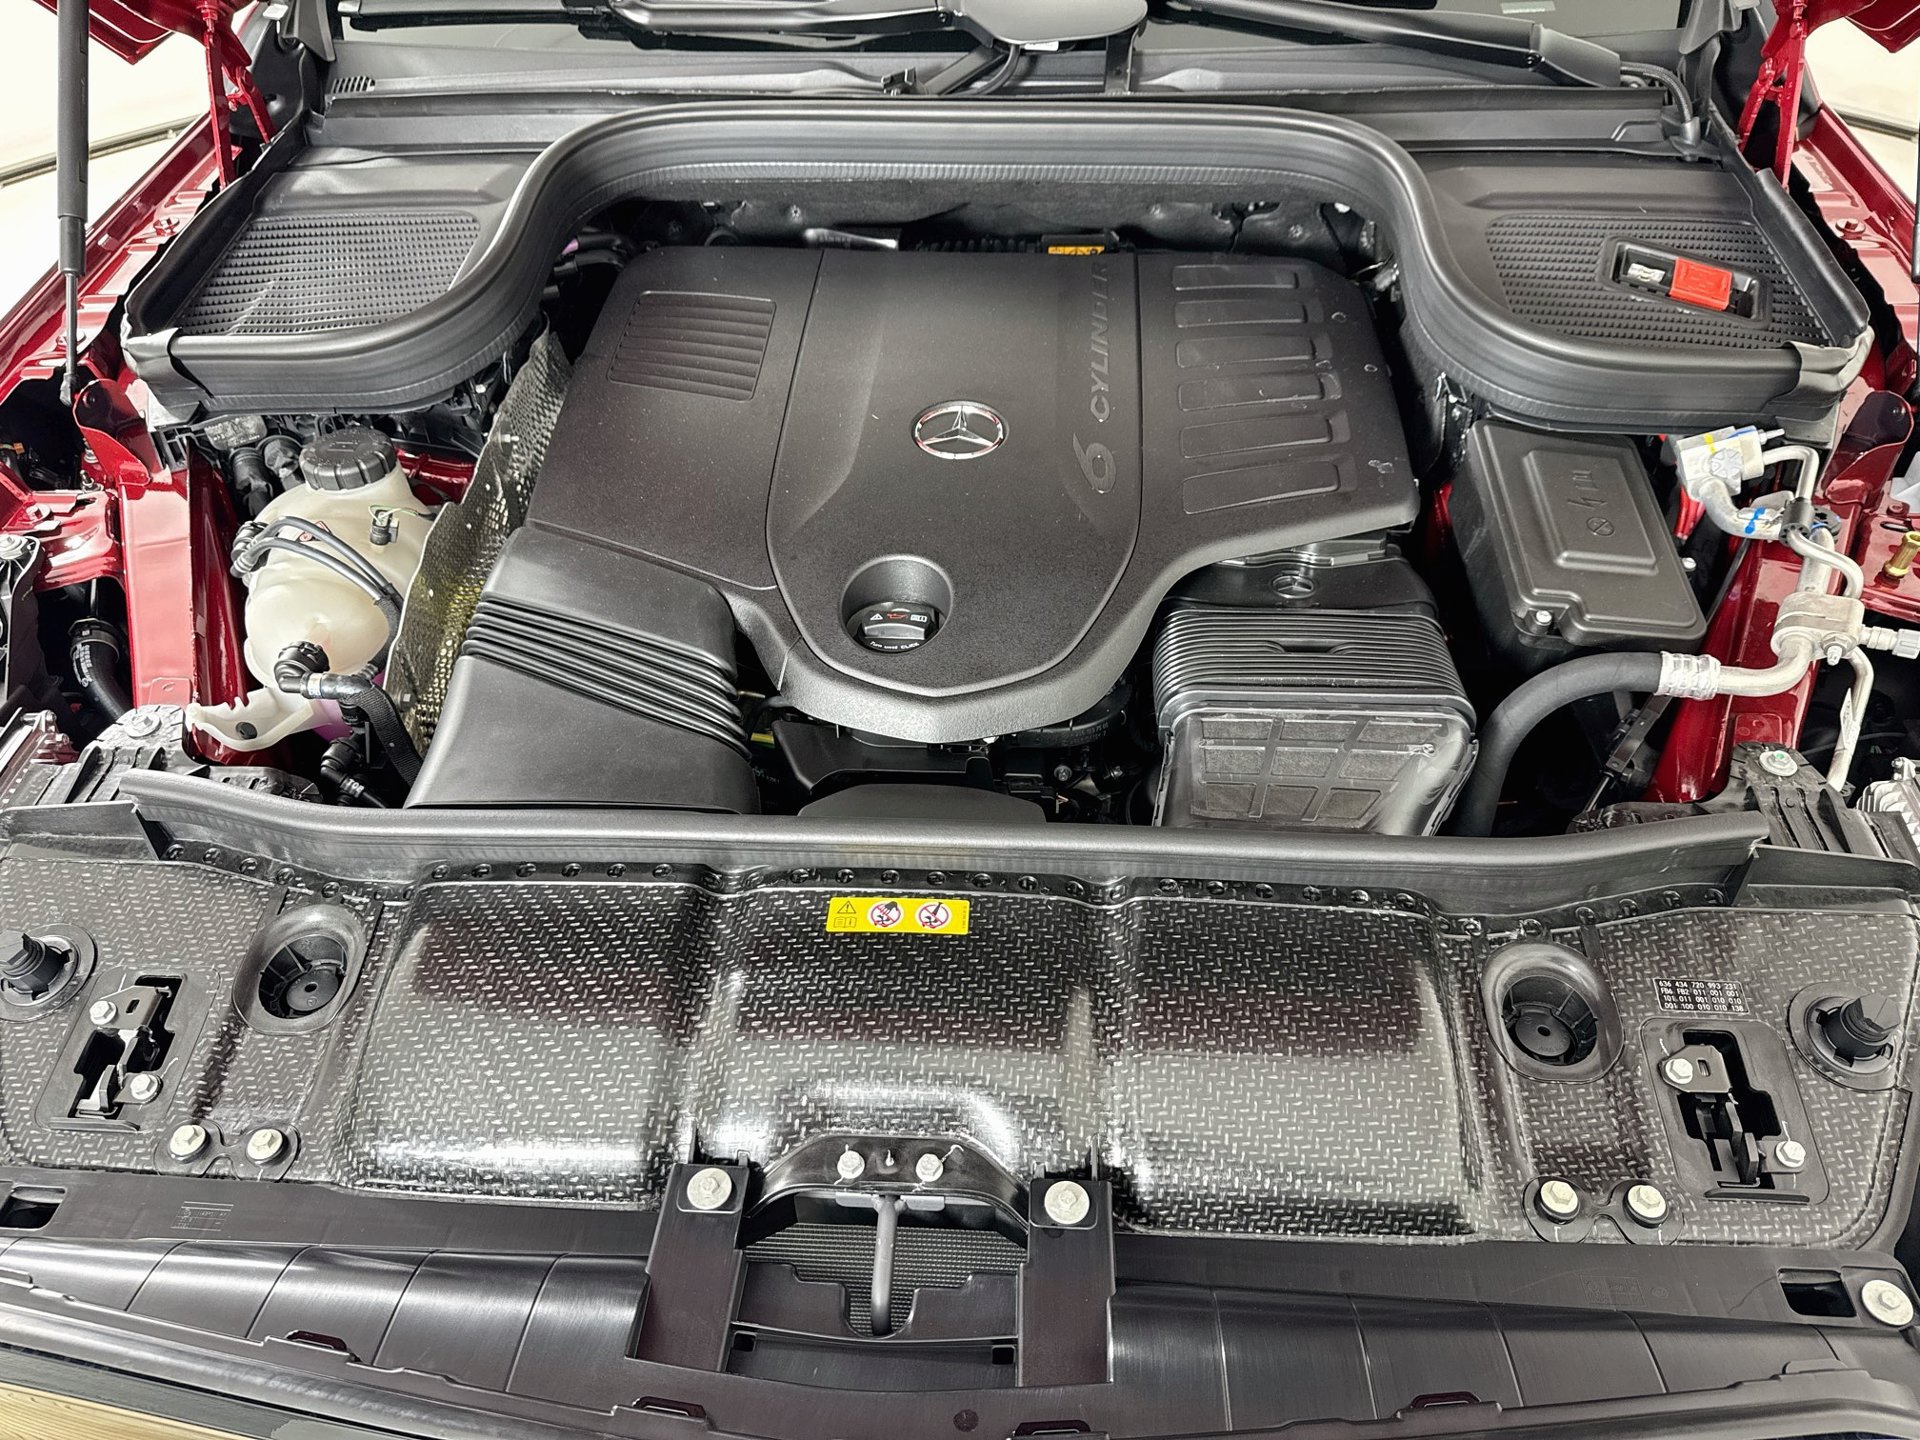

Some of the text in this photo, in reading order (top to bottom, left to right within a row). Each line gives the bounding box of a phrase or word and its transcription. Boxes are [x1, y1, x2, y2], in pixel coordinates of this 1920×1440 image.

[1073, 262, 1117, 494] 6 CYLINDER
[1691, 981, 1705, 989] 720
[1709, 989, 1723, 997] 001
[1728, 997, 1742, 1005] 010
